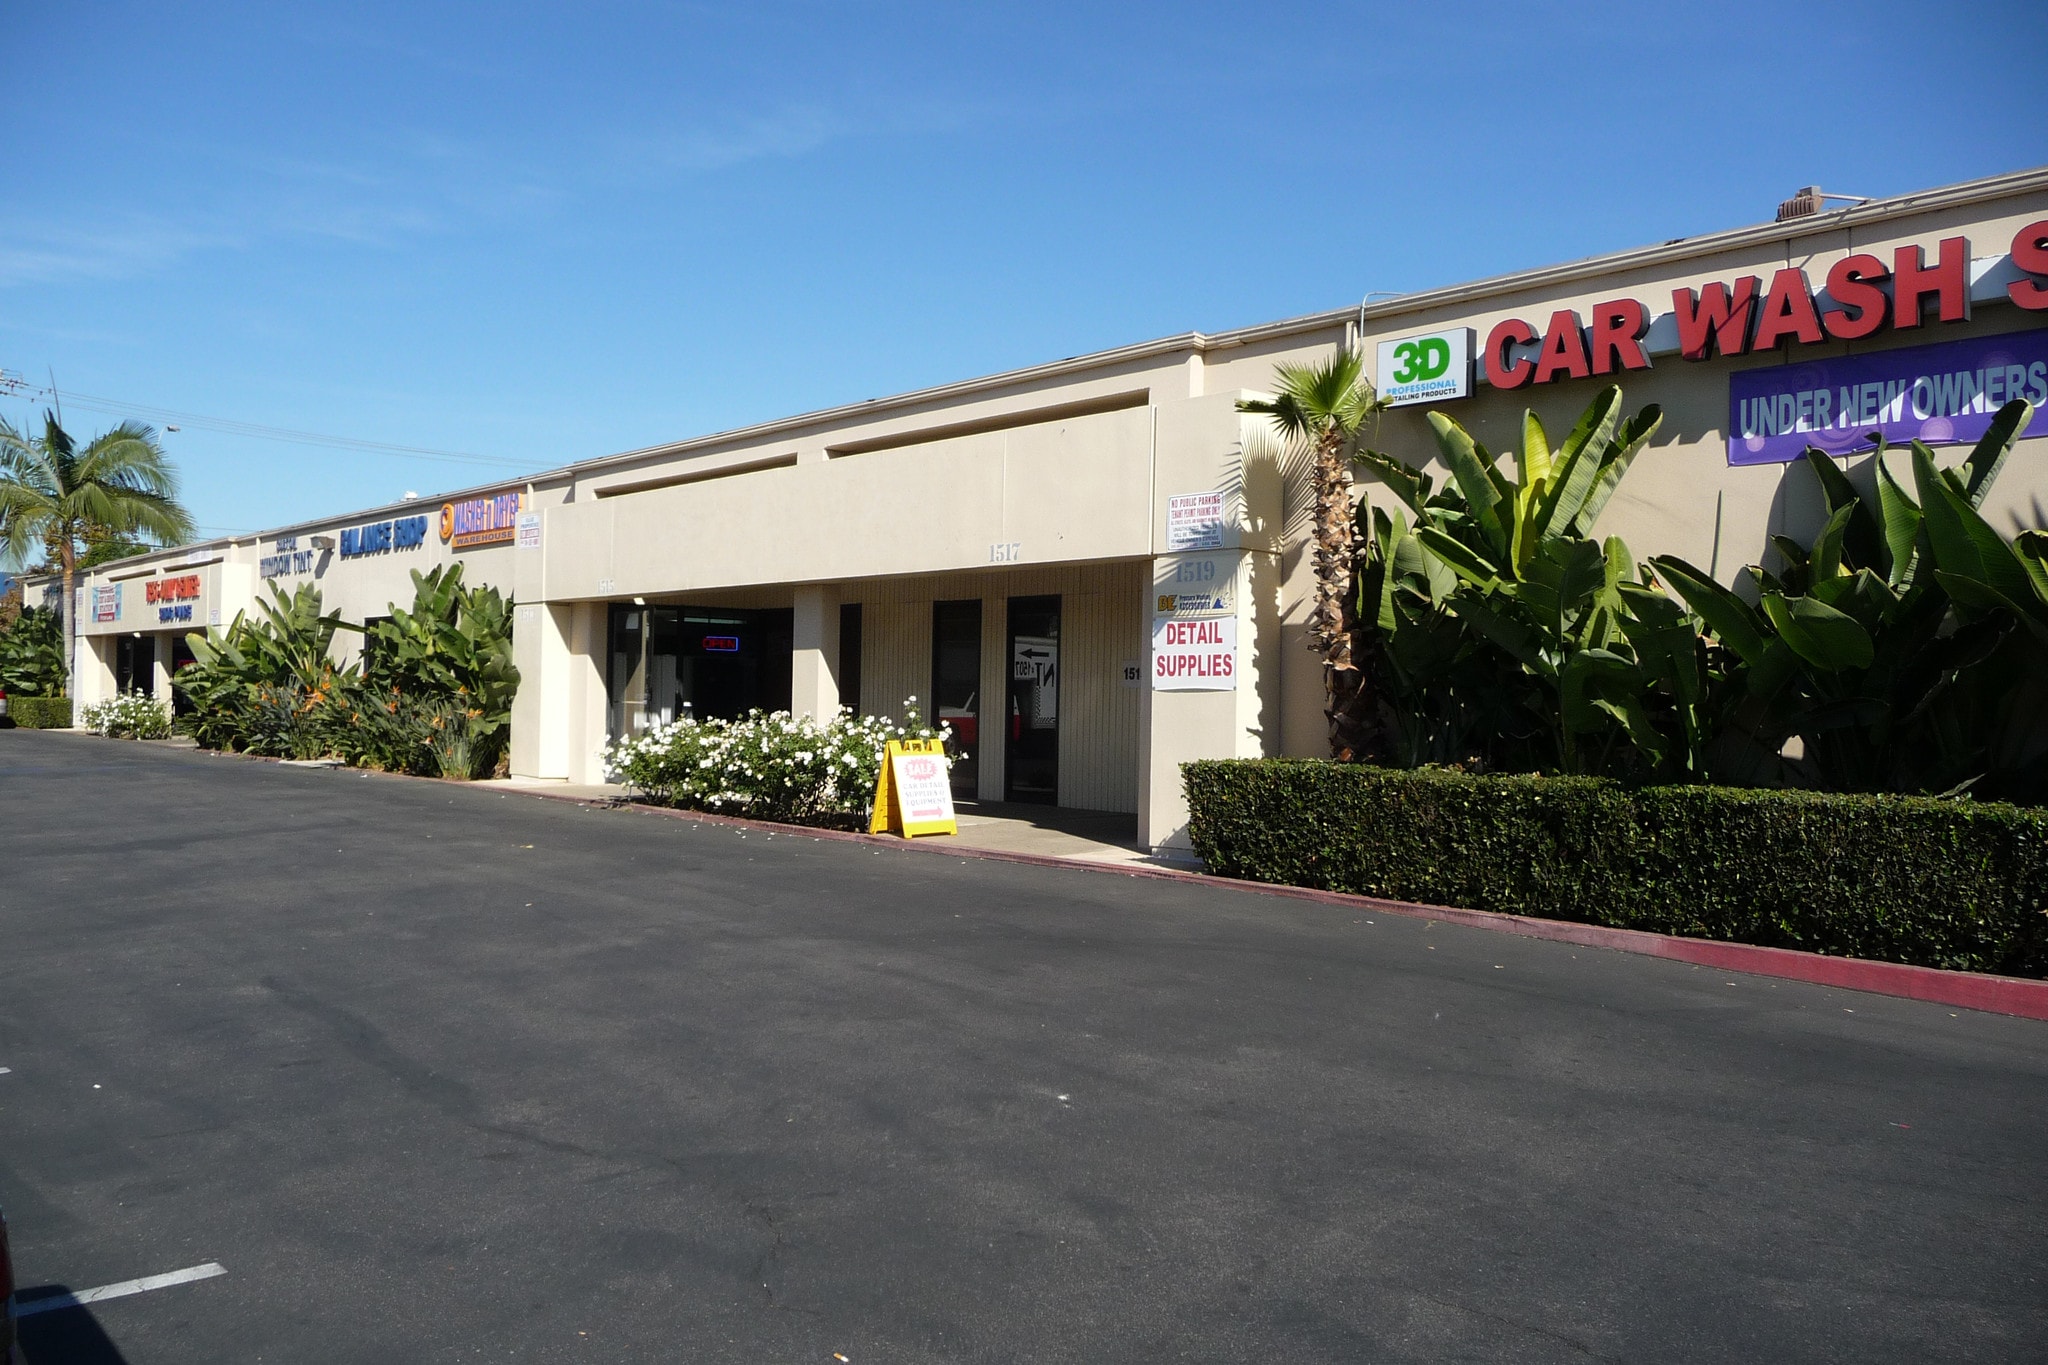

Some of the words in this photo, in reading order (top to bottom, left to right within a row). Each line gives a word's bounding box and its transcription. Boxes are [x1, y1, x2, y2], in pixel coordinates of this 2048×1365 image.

[1485, 299, 1650, 389] CAR
[1672, 236, 1970, 361] WASH
[1393, 338, 1450, 384] 3D
[1386, 379, 1457, 396] PROFESSIONAL
[1393, 392, 1420, 401] TAILING
[1422, 387, 1457, 398] PRODUCTS
[1740, 388, 1833, 440] UNDER
[1839, 379, 1906, 429] NEW
[1171, 499, 1179, 508] NO
[1180, 497, 1197, 507] PUBLIC
[1198, 494, 1221, 506] PARKING
[454, 499, 485, 536] WASHER
[456, 530, 513, 545] WAREHOUSE
[989, 542, 1021, 562] 1517
[260, 554, 291, 577] WINDOW
[293, 549, 313, 573] TINT
[1176, 560, 1215, 582] 1519
[1166, 621, 1223, 645] DETAIL
[703, 638, 735, 649] OPEN
[1156, 653, 1233, 677] SUPPLIES
[1123, 667, 1141, 681] 151
[908, 762, 932, 776] SALE
[903, 782, 918, 790] CAR
[919, 781, 944, 789] DETAIL
[905, 789, 938, 798] SUPPLIES
[906, 797, 946, 807] EQUIPMENT
